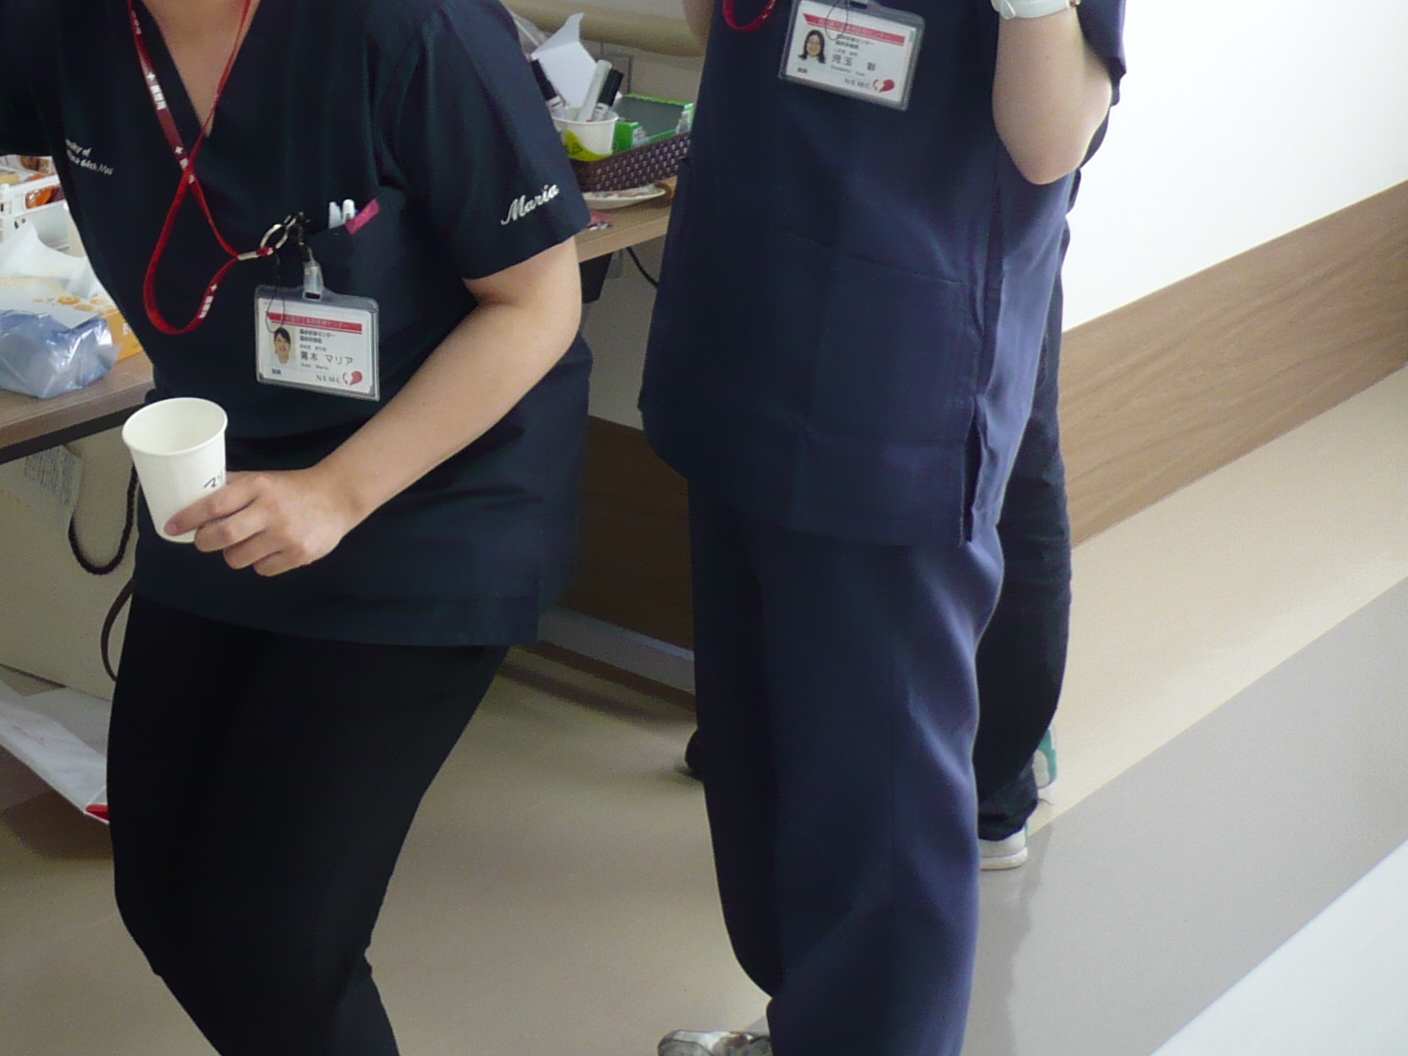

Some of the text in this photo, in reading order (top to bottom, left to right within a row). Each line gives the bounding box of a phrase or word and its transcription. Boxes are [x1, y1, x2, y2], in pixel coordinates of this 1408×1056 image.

[500, 183, 560, 226] Maria
[324, 354, 354, 365] マリア
